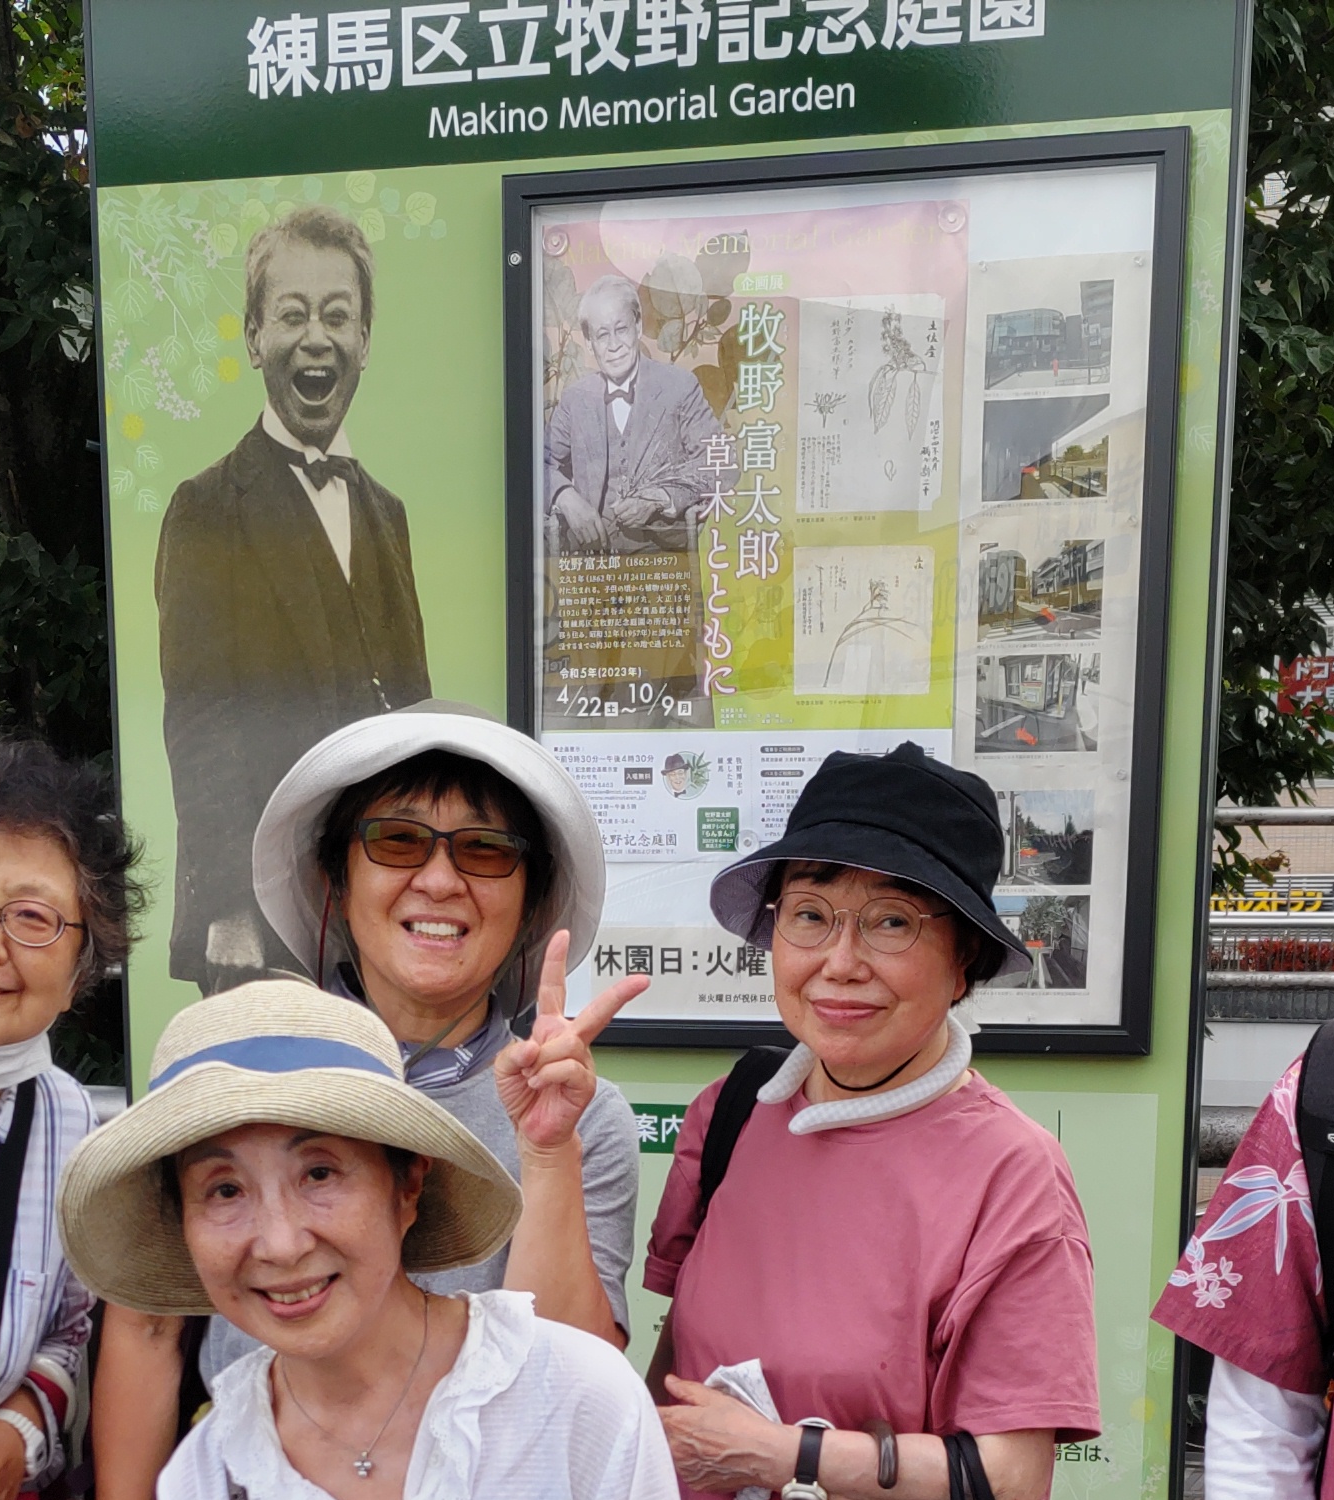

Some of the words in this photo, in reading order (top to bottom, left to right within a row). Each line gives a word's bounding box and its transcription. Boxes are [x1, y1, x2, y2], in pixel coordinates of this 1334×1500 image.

[428, 101, 548, 138] Makino
[559, 83, 718, 130] Memorial
[729, 77, 856, 117] Garden
[680, 224, 818, 258] Memorial
[740, 274, 785, 292] 企画展
[735, 302, 786, 580] 牧野富太郎
[558, 555, 621, 572] 牧野富太郎
[698, 433, 738, 698] 草木とともに
[559, 666, 643, 680] 令和5年(2023年)
